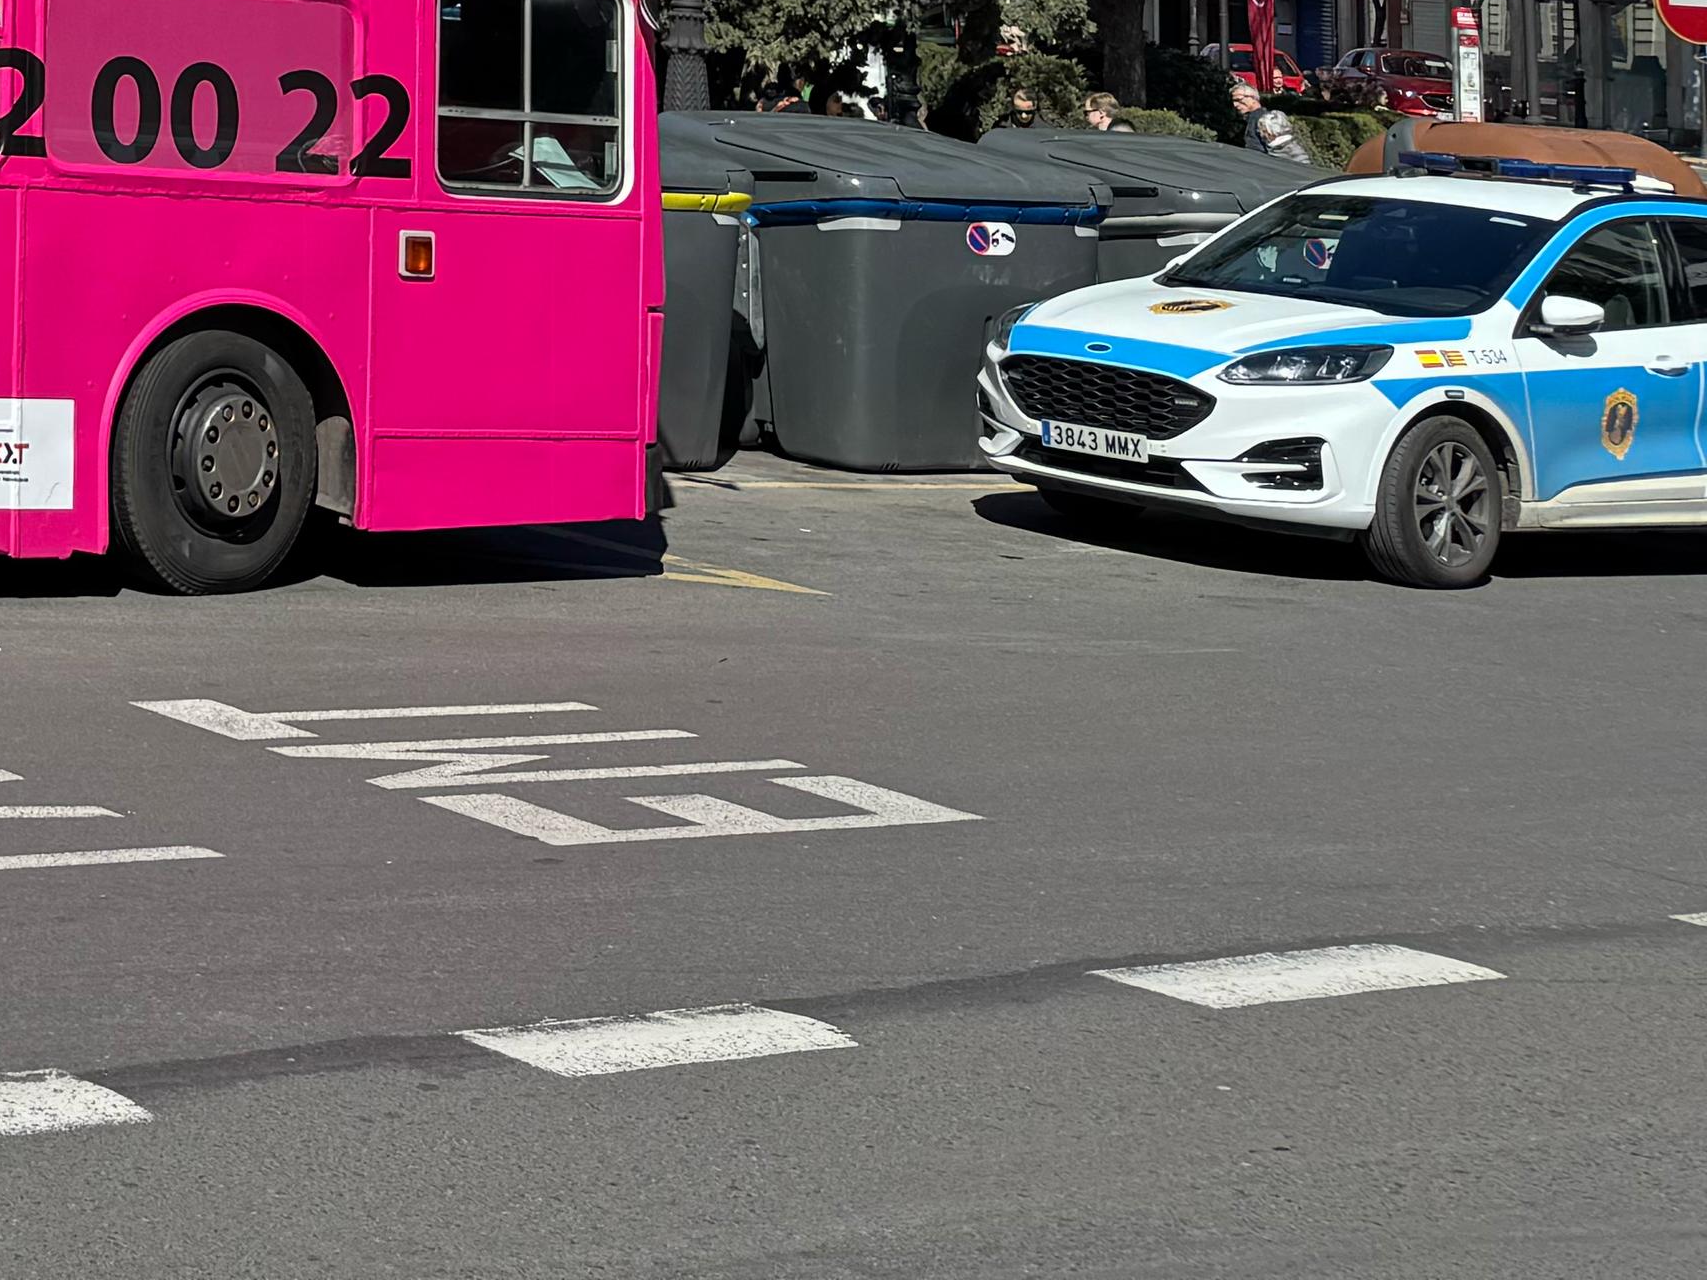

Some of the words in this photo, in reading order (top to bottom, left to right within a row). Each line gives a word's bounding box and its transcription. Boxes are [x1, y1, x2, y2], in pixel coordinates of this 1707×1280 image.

[90, 55, 240, 171] 00
[275, 70, 412, 178] 22
[1053, 425, 1099, 451] 3843
[1104, 433, 1143, 459] MMX
[128, 699, 989, 847] EMT
